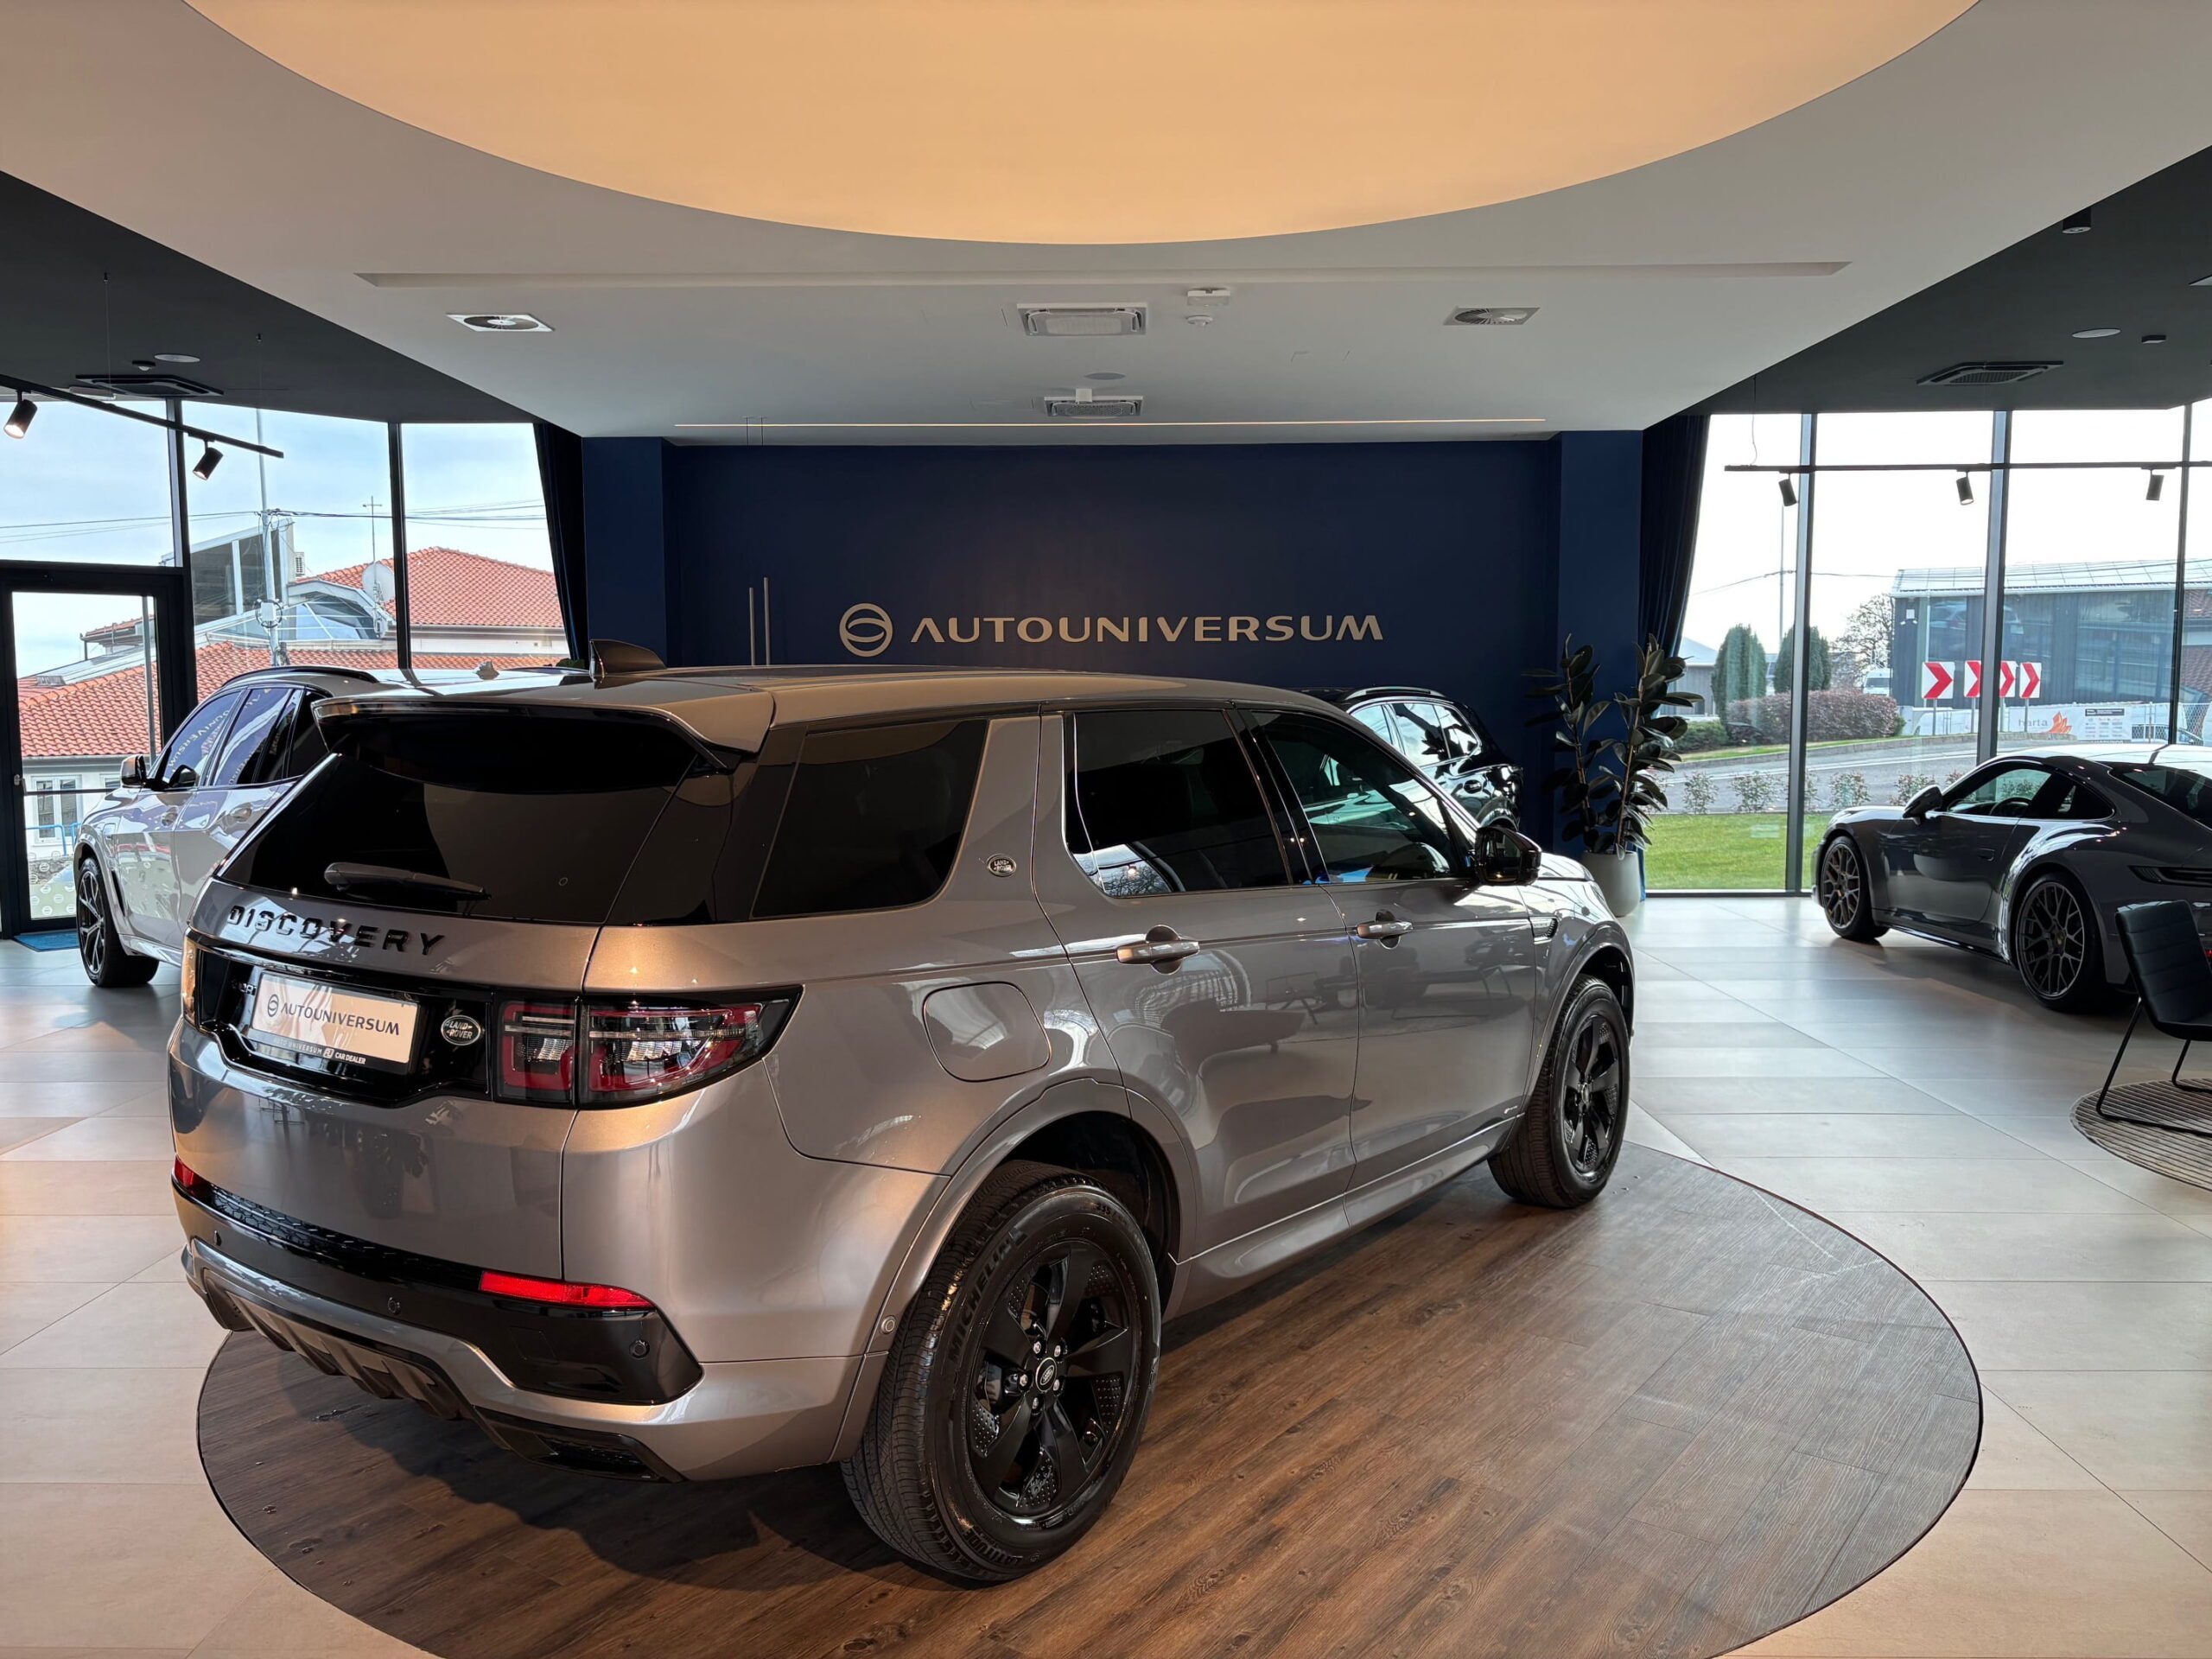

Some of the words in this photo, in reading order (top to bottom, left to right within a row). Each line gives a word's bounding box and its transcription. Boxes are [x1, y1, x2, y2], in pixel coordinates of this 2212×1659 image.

[911, 615, 1383, 643] AUTOUNIVERSUM
[226, 905, 445, 956] DISCOVERY
[280, 1005, 400, 1036] AUTOUNIVERSUM
[448, 1021, 468, 1030] LAND
[449, 1028, 473, 1039] ROVER
[288, 1040, 322, 1055] UNIVERSUM
[335, 1052, 346, 1060] CAR
[346, 1053, 366, 1065] DEALER
[947, 1237, 1014, 1362] MICHELIN
